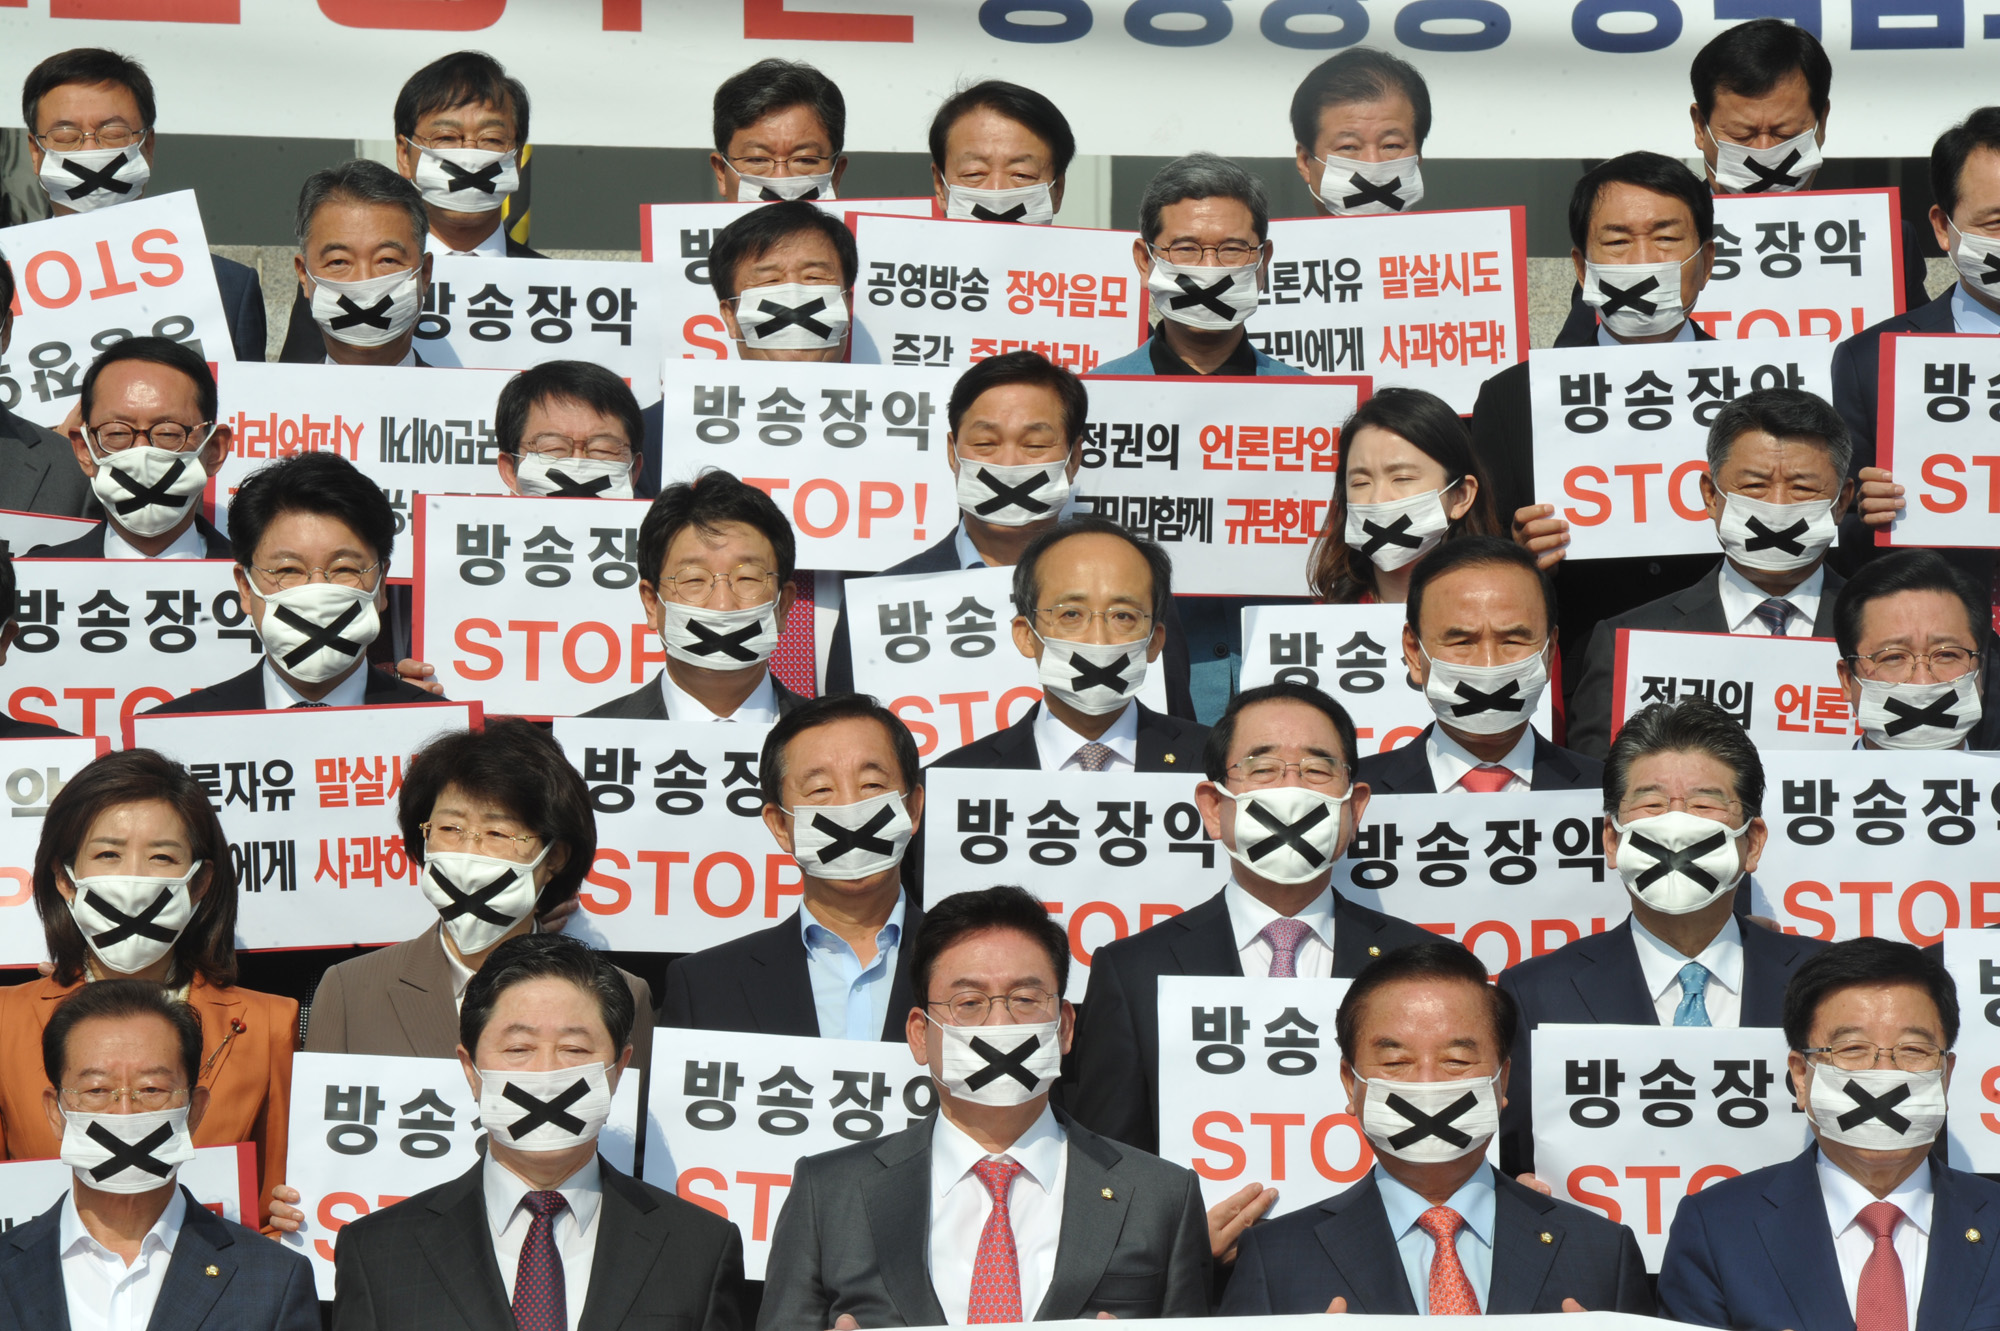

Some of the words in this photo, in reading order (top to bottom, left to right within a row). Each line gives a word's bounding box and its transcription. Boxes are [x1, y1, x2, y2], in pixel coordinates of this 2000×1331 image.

[9, 228, 184, 317] STO
[868, 262, 989, 312] 공영방송
[1006, 270, 1127, 318] 장악음모
[1379, 251, 1502, 299] 말살시도
[1379, 320, 1506, 369] 사과하라!
[693, 385, 936, 451] 방송장악
[1081, 422, 1180, 471] 정권의
[1199, 425, 1341, 473] 언론탄압
[1774, 684, 1863, 735] 언론
[1347, 817, 1605, 889] 방송장악
[1191, 1111, 1374, 1183] STO
